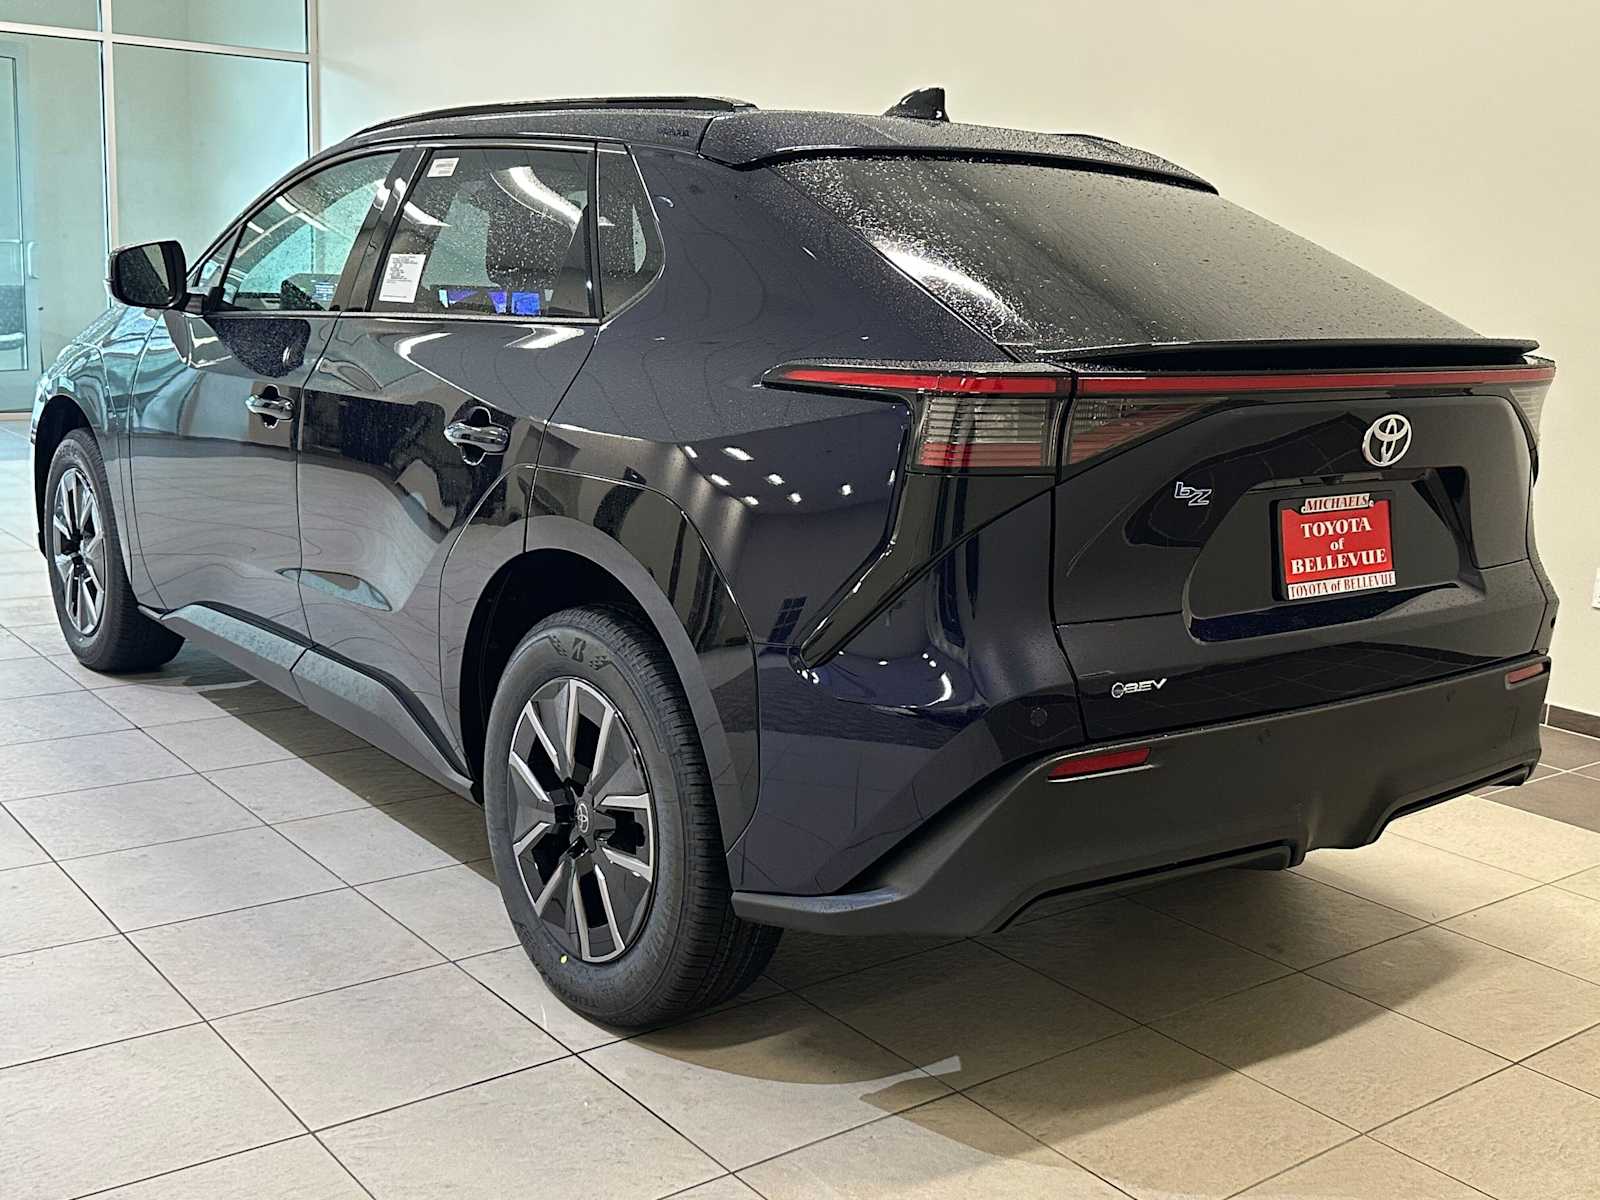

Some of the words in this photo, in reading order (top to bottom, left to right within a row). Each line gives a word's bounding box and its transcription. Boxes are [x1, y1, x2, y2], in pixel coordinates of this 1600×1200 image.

[1301, 517, 1371, 538] TOYOTA
[1330, 538, 1344, 550] of
[1291, 549, 1386, 574] BELLEVUE
[1290, 583, 1327, 598] TOYOTA
[1330, 581, 1342, 592] of
[1343, 573, 1394, 589] BELLEVUE
